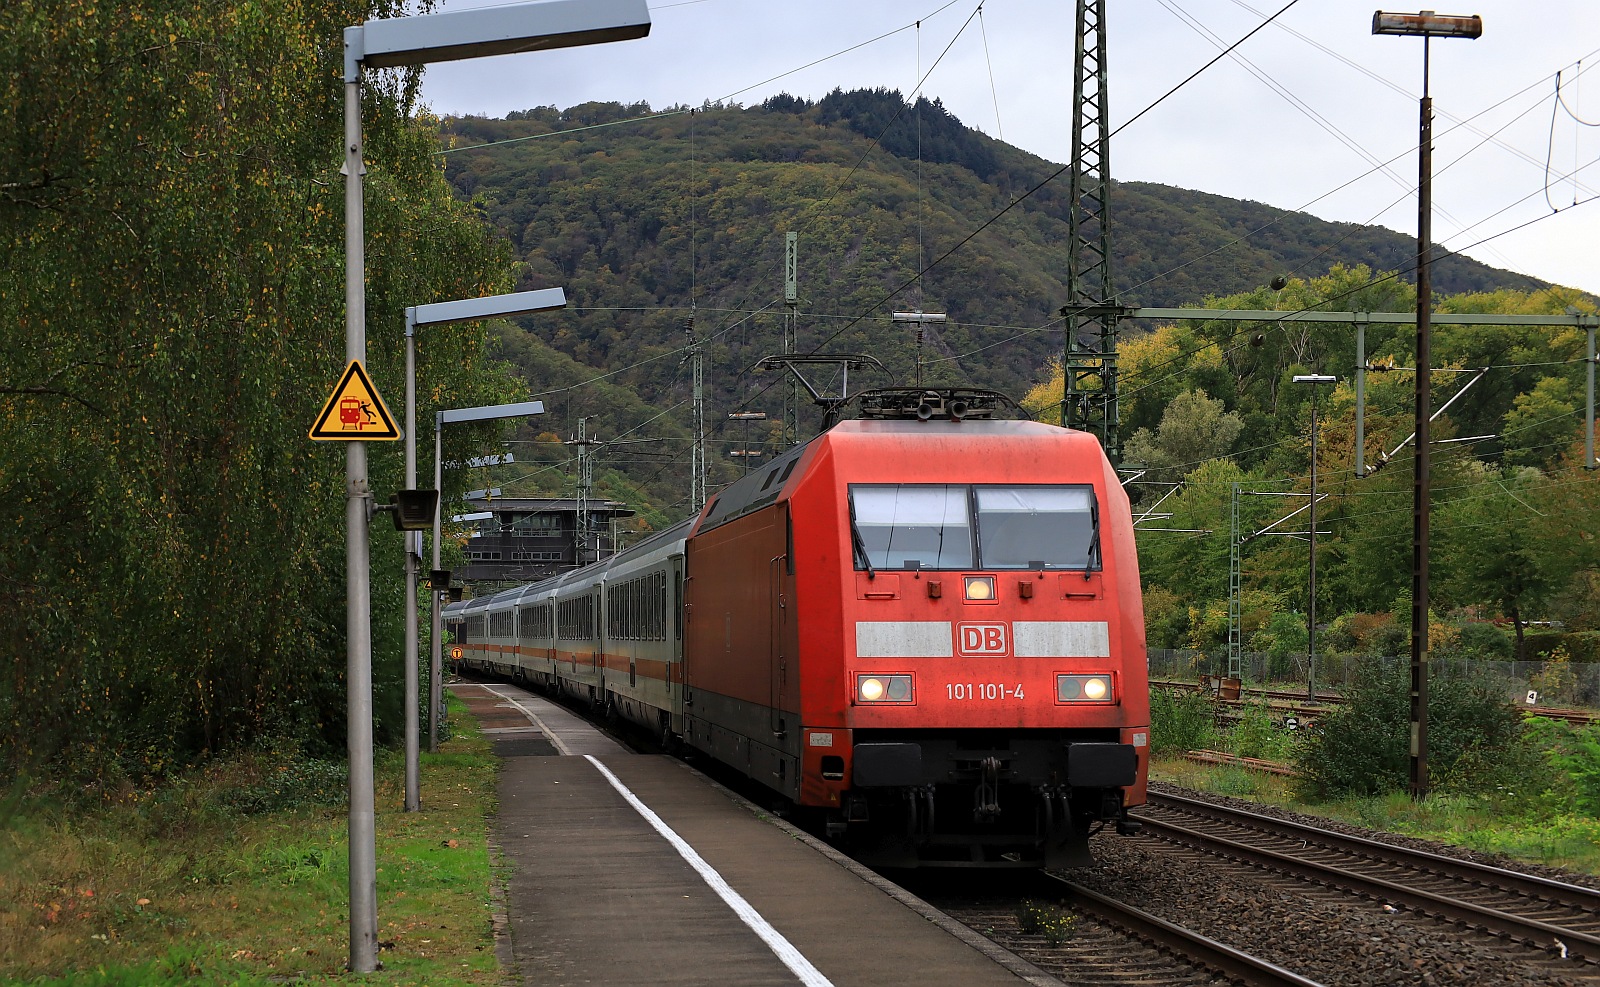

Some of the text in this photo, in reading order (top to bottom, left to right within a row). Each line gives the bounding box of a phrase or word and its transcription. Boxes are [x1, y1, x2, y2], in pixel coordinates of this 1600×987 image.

[963, 627, 1003, 651] DB
[946, 683, 1025, 700] 101 101-4
